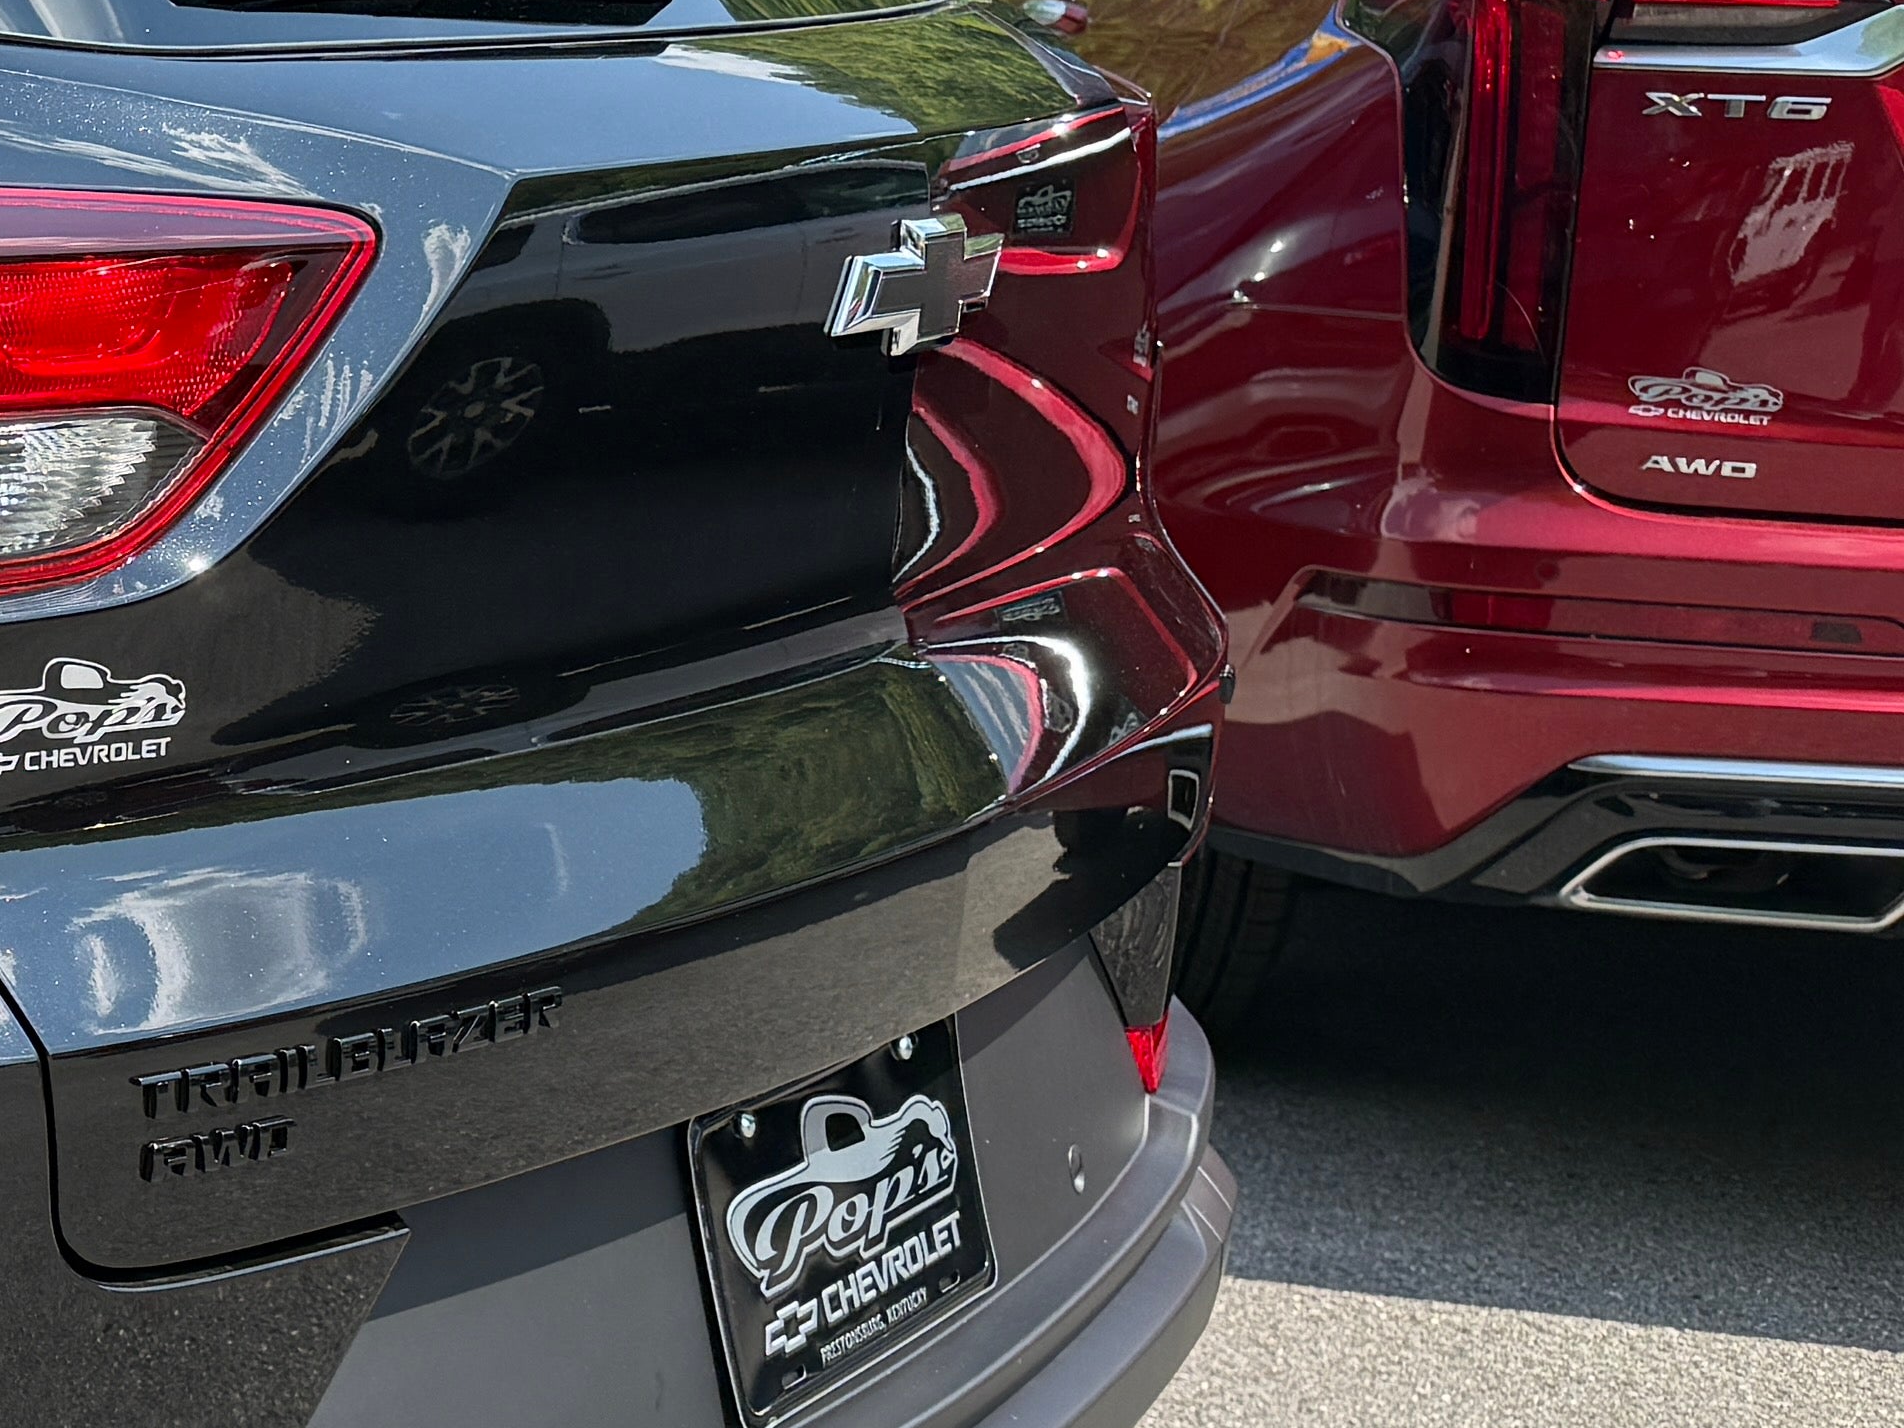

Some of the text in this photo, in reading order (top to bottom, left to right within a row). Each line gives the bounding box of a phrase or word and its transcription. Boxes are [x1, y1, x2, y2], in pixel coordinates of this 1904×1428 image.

[1642, 91, 1832, 120] XT6
[1667, 408, 1772, 426] CHEVROLET
[1641, 455, 1757, 479] AWD
[24, 736, 172, 771] CHEVROLET
[128, 985, 564, 1119] TRAILBLAZER
[138, 1114, 296, 1183] AWD
[754, 1143, 949, 1277] Pop's
[821, 1210, 961, 1323] CHEVROLET
